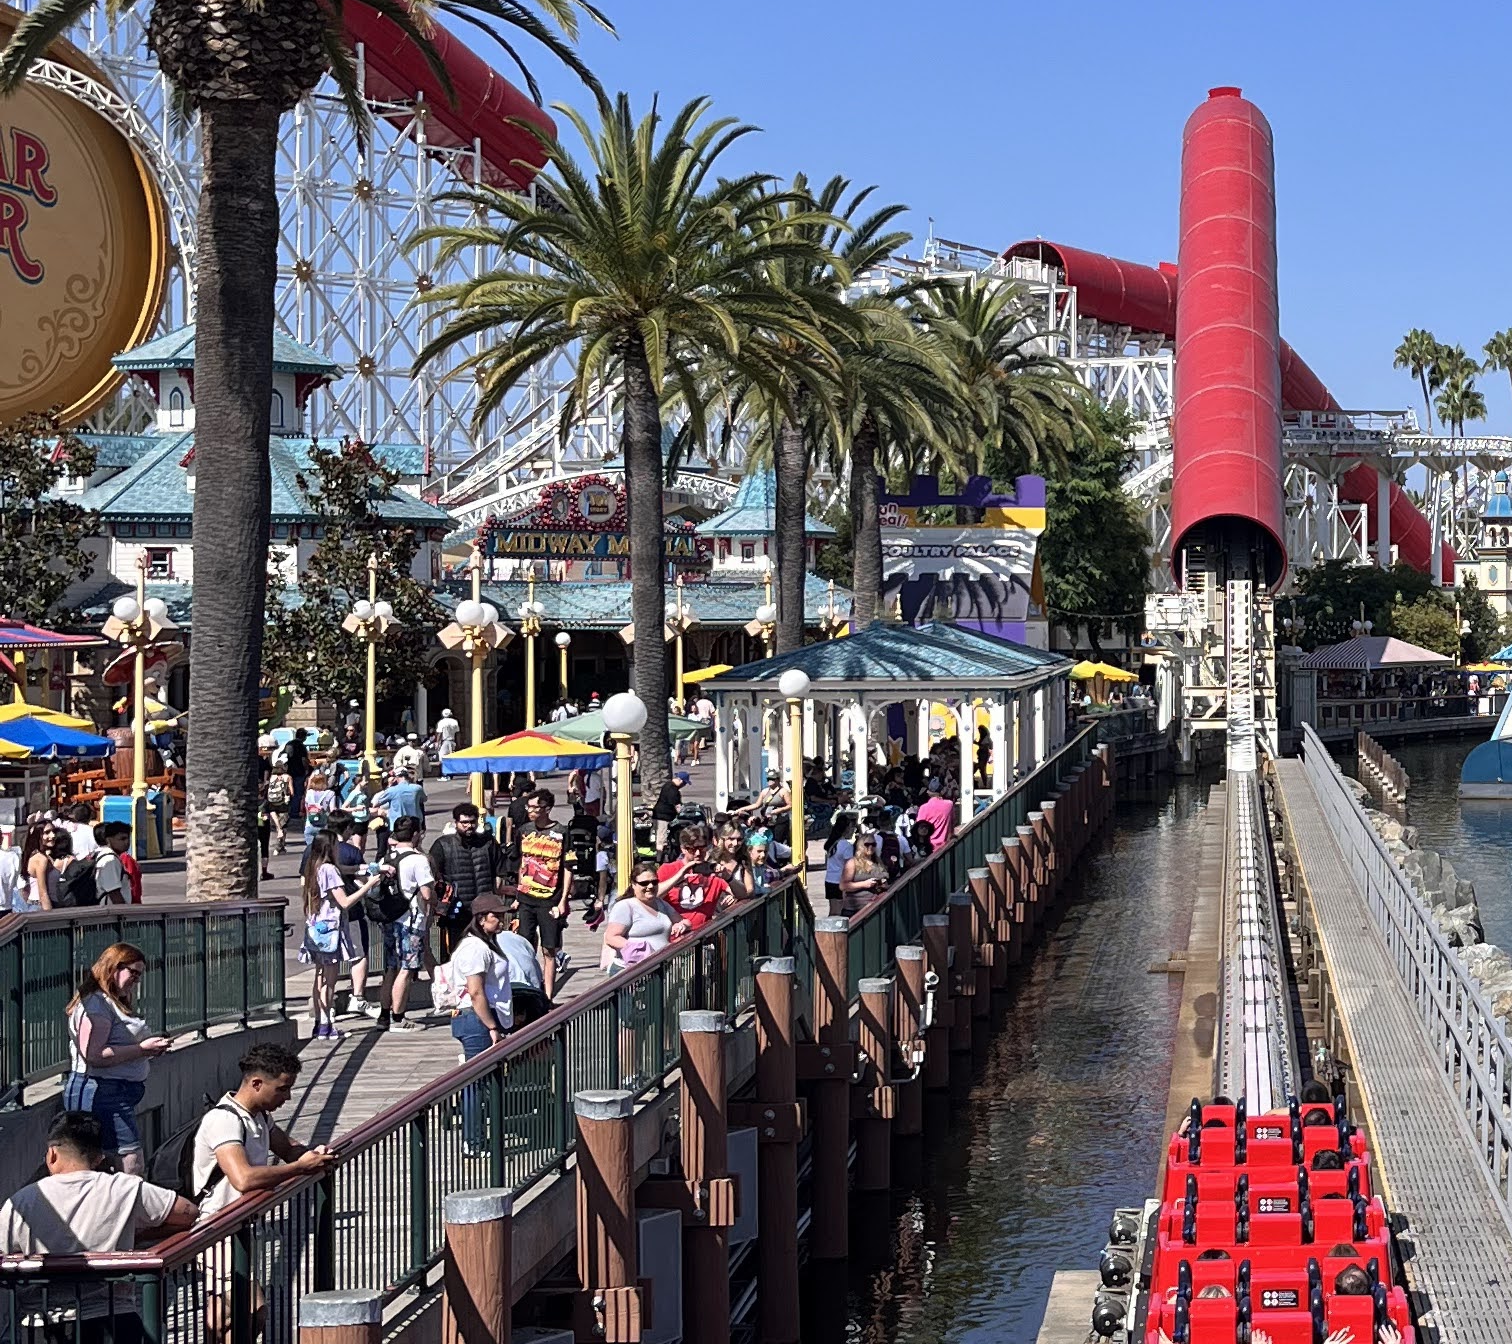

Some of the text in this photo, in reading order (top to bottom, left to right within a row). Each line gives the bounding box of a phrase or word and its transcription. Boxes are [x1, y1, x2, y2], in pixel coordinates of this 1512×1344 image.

[879, 503, 898, 516] un
[879, 514, 908, 527] eal!
[496, 531, 601, 555] MIDWAY
[881, 545, 1021, 558] POULTRY PALACE
